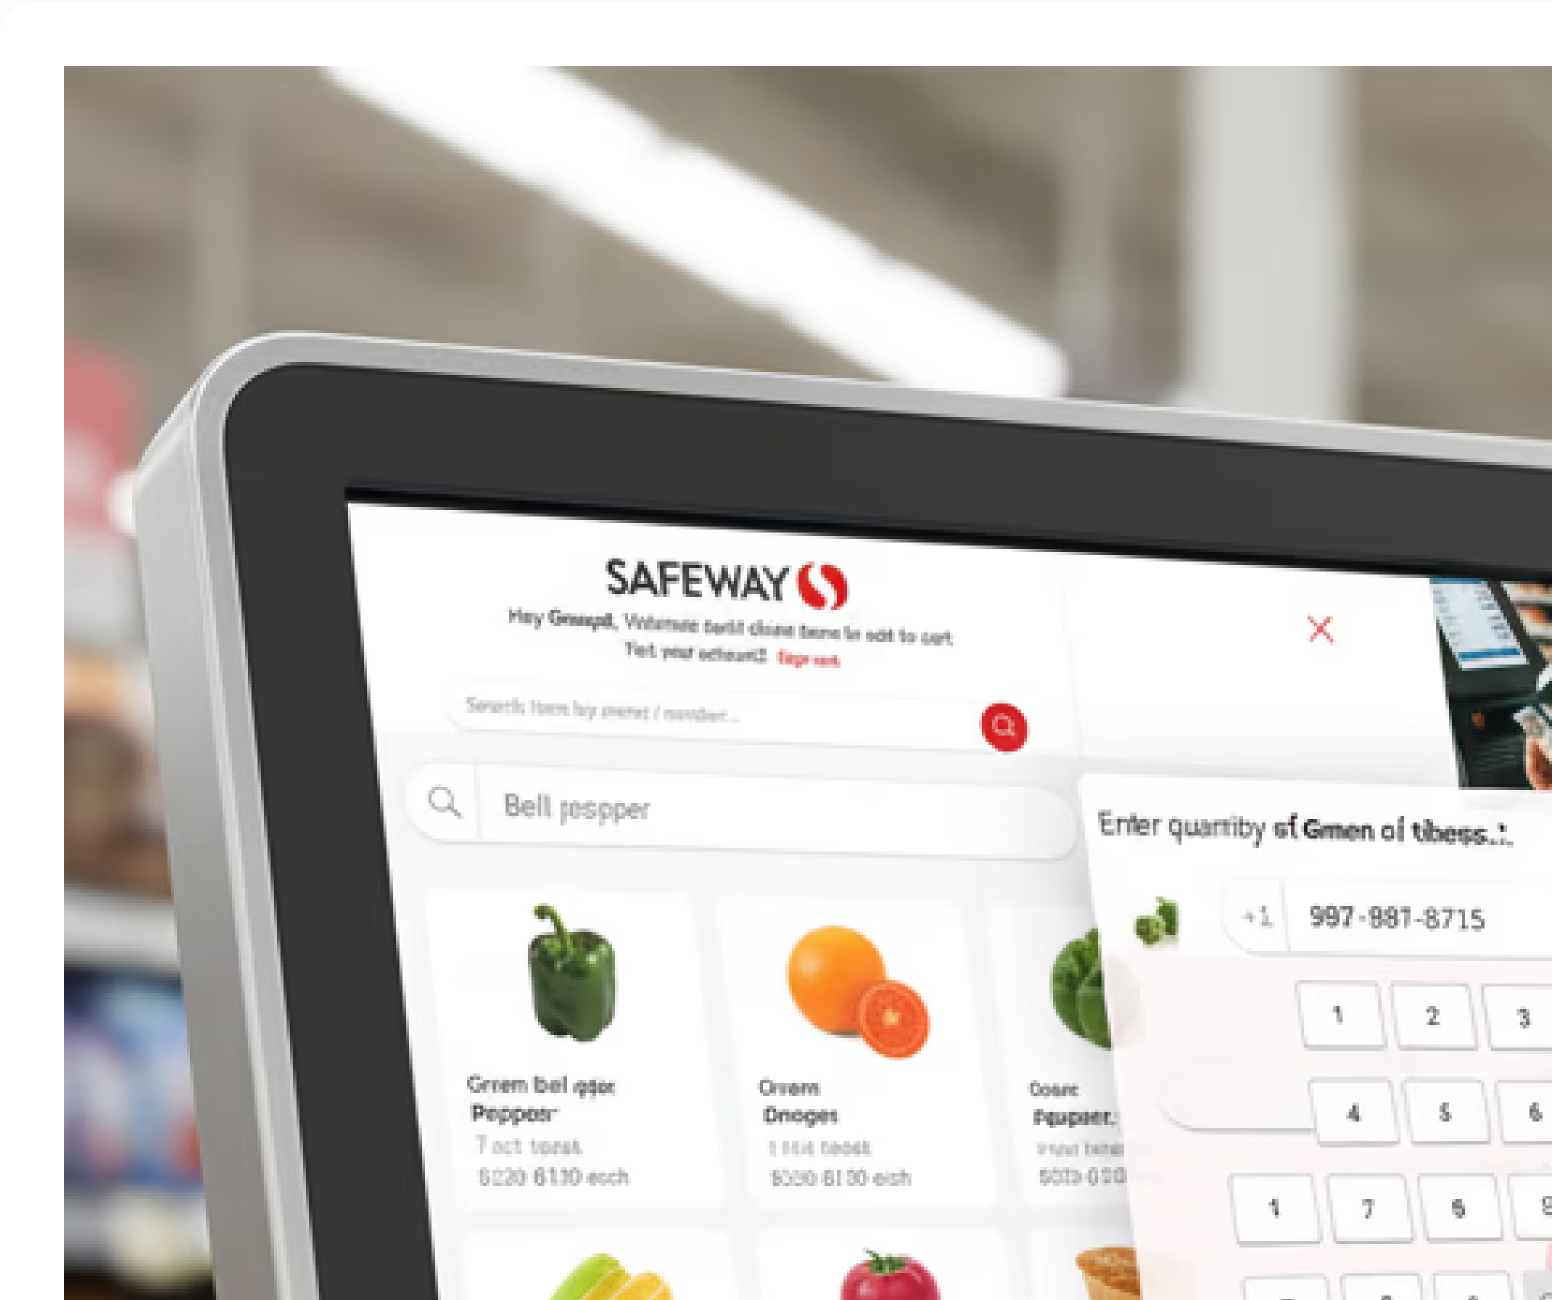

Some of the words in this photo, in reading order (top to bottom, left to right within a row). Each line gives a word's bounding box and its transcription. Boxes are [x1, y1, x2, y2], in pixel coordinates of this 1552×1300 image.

[606, 558, 789, 601] SAFEWAY
[505, 793, 551, 819] Bell
[1426, 1006, 1440, 1025] 2
[1517, 1009, 1530, 1029] 3
[1346, 1103, 1359, 1122] 4
[1529, 1102, 1543, 1122] 6
